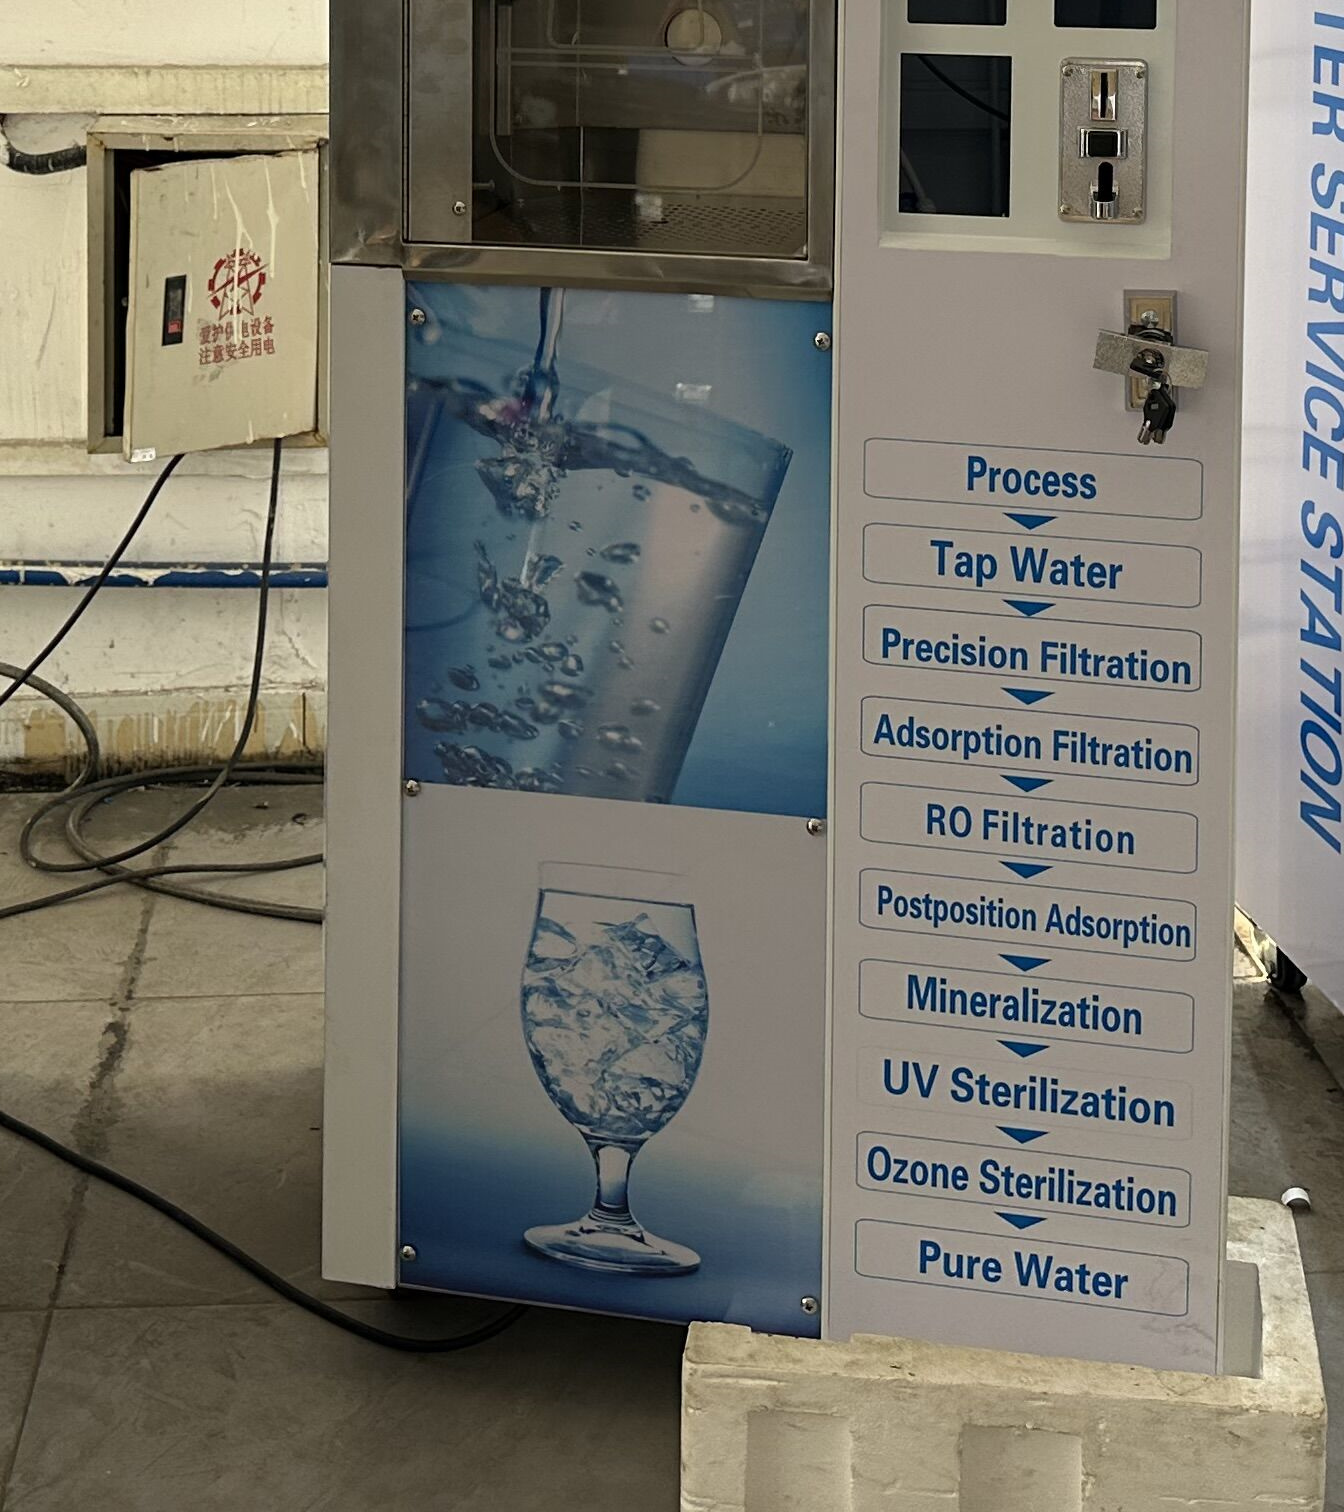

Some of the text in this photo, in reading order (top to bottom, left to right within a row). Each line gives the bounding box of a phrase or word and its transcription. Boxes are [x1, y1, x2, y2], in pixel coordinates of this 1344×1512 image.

[200, 336, 275, 365] 注意安全用电
[967, 455, 1097, 499] Process
[930, 540, 1123, 589] Tap Water
[882, 628, 1192, 684] Precision Filtration
[1300, 500, 1344, 855] STATION
[873, 714, 1192, 773] Adsorption Filtration
[926, 804, 1135, 855] RO Filtration
[878, 886, 1191, 948] Postposition Adsorption
[907, 974, 1142, 1035] Mineralization
[883, 1059, 1175, 1127] UV Sterilization
[867, 1145, 1177, 1217] Ozone Sterilization
[919, 1240, 1128, 1299] Pure Water
